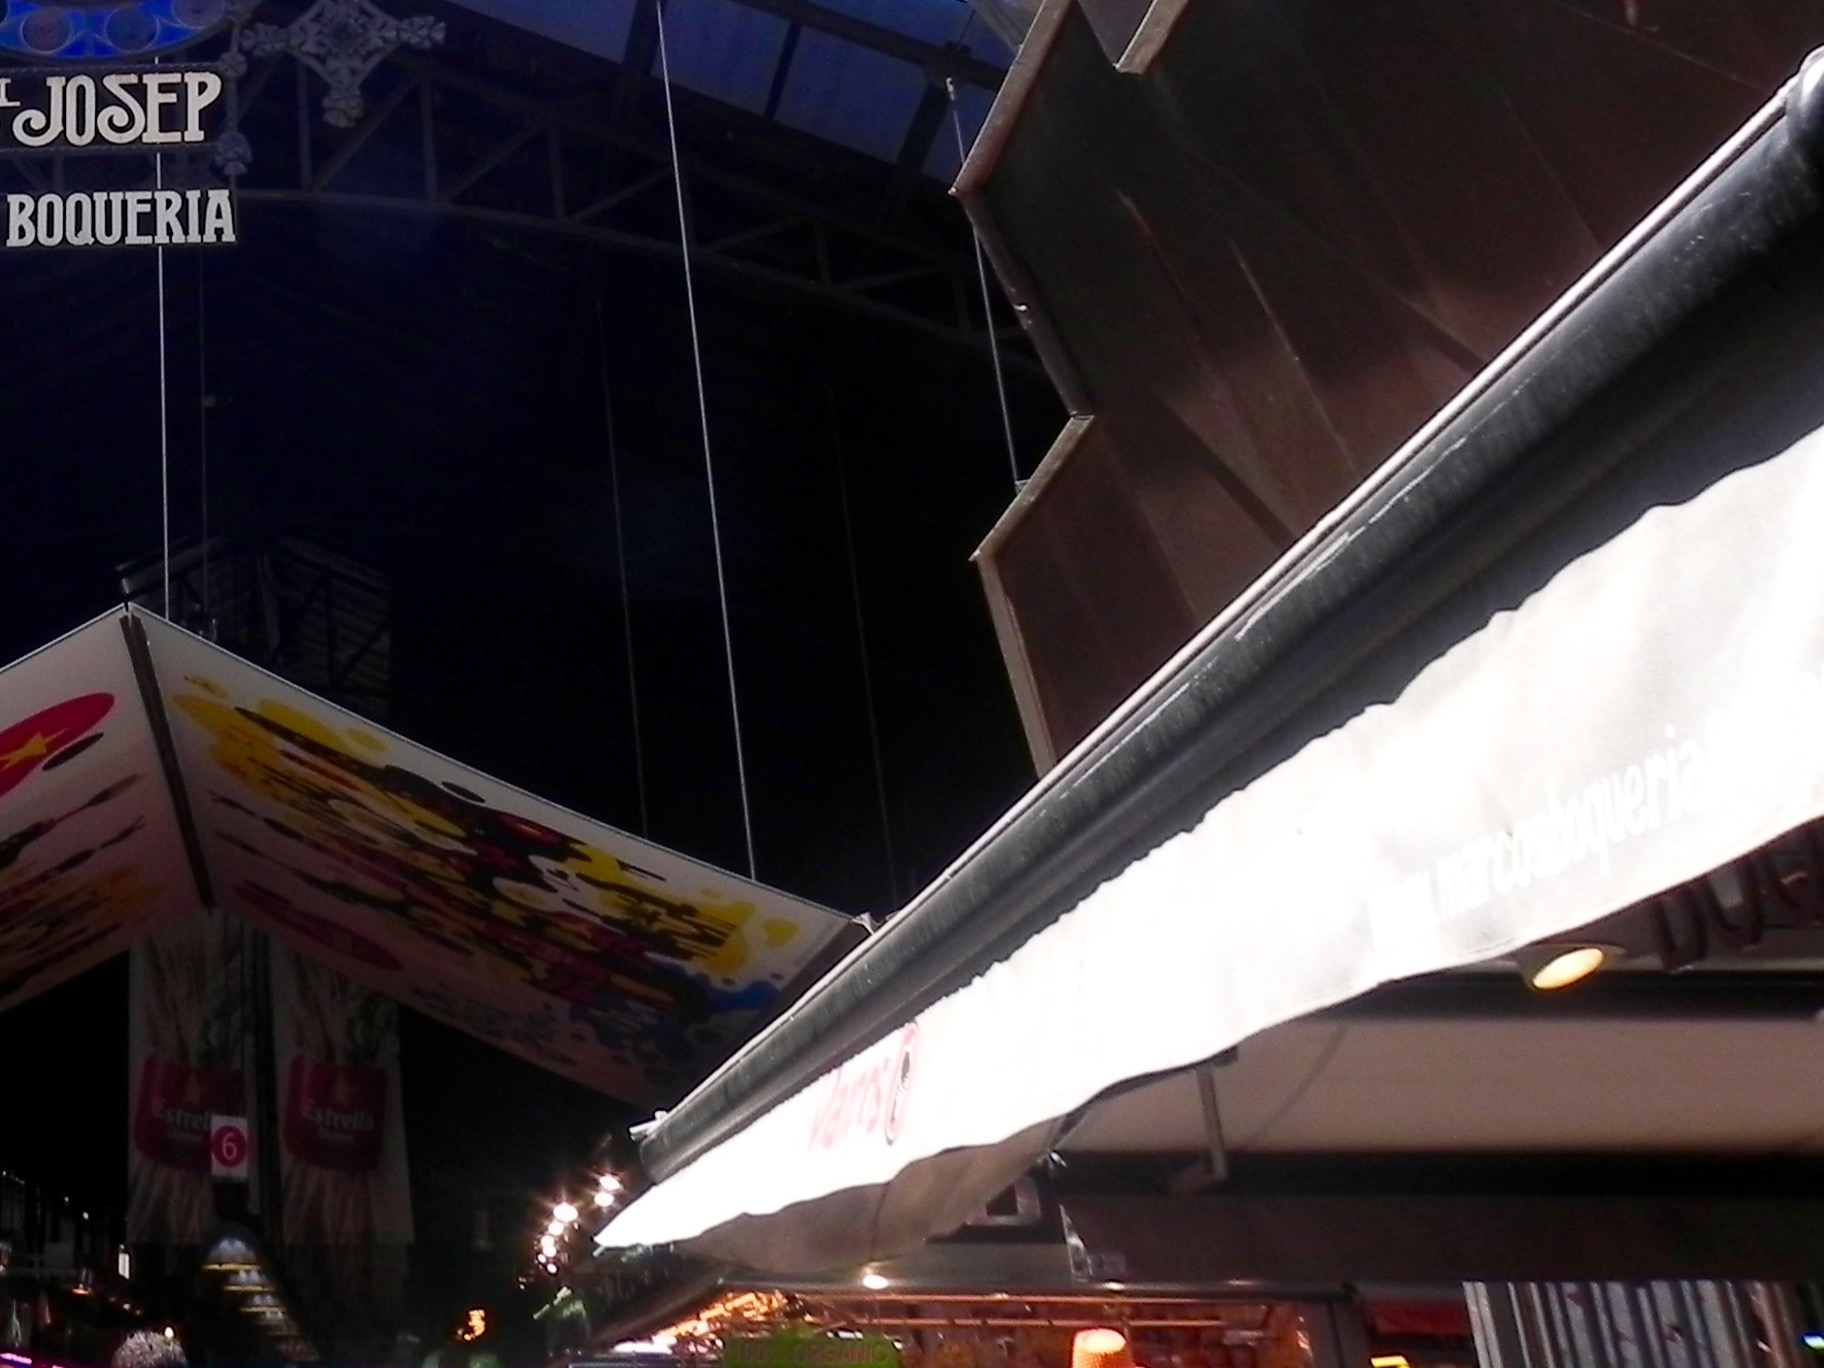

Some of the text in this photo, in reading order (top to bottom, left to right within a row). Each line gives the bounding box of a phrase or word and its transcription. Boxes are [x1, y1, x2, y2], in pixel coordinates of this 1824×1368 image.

[12, 71, 222, 147] JOSEP
[6, 189, 236, 247] BOQUERIA
[221, 1131, 239, 1161] 6
